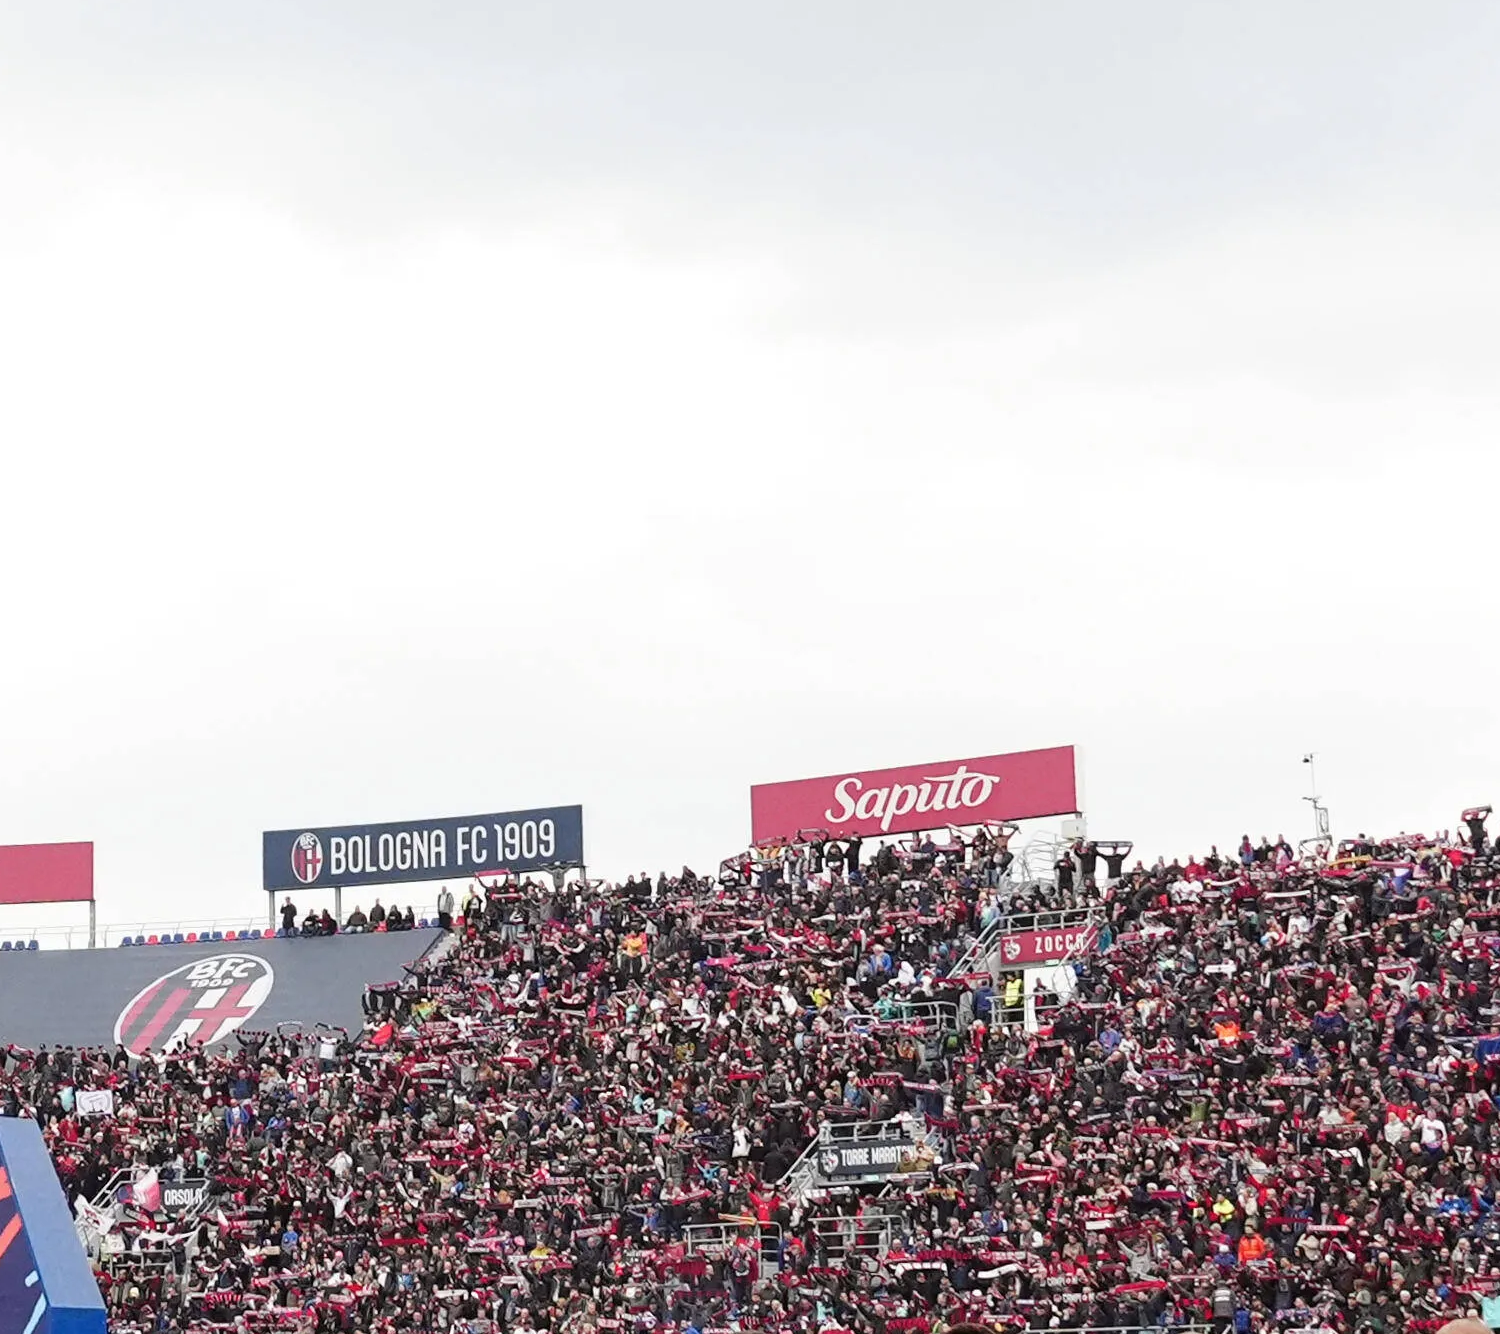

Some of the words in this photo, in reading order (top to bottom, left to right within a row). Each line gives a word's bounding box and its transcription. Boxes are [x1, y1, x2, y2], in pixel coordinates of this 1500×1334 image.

[825, 766, 1000, 831] Saputo
[330, 829, 447, 875] BOLOGNA
[457, 824, 487, 865] FC
[495, 819, 555, 863] 1909
[185, 956, 258, 979] BFC
[190, 978, 235, 988] 1909
[840, 1148, 869, 1166] TORRE
